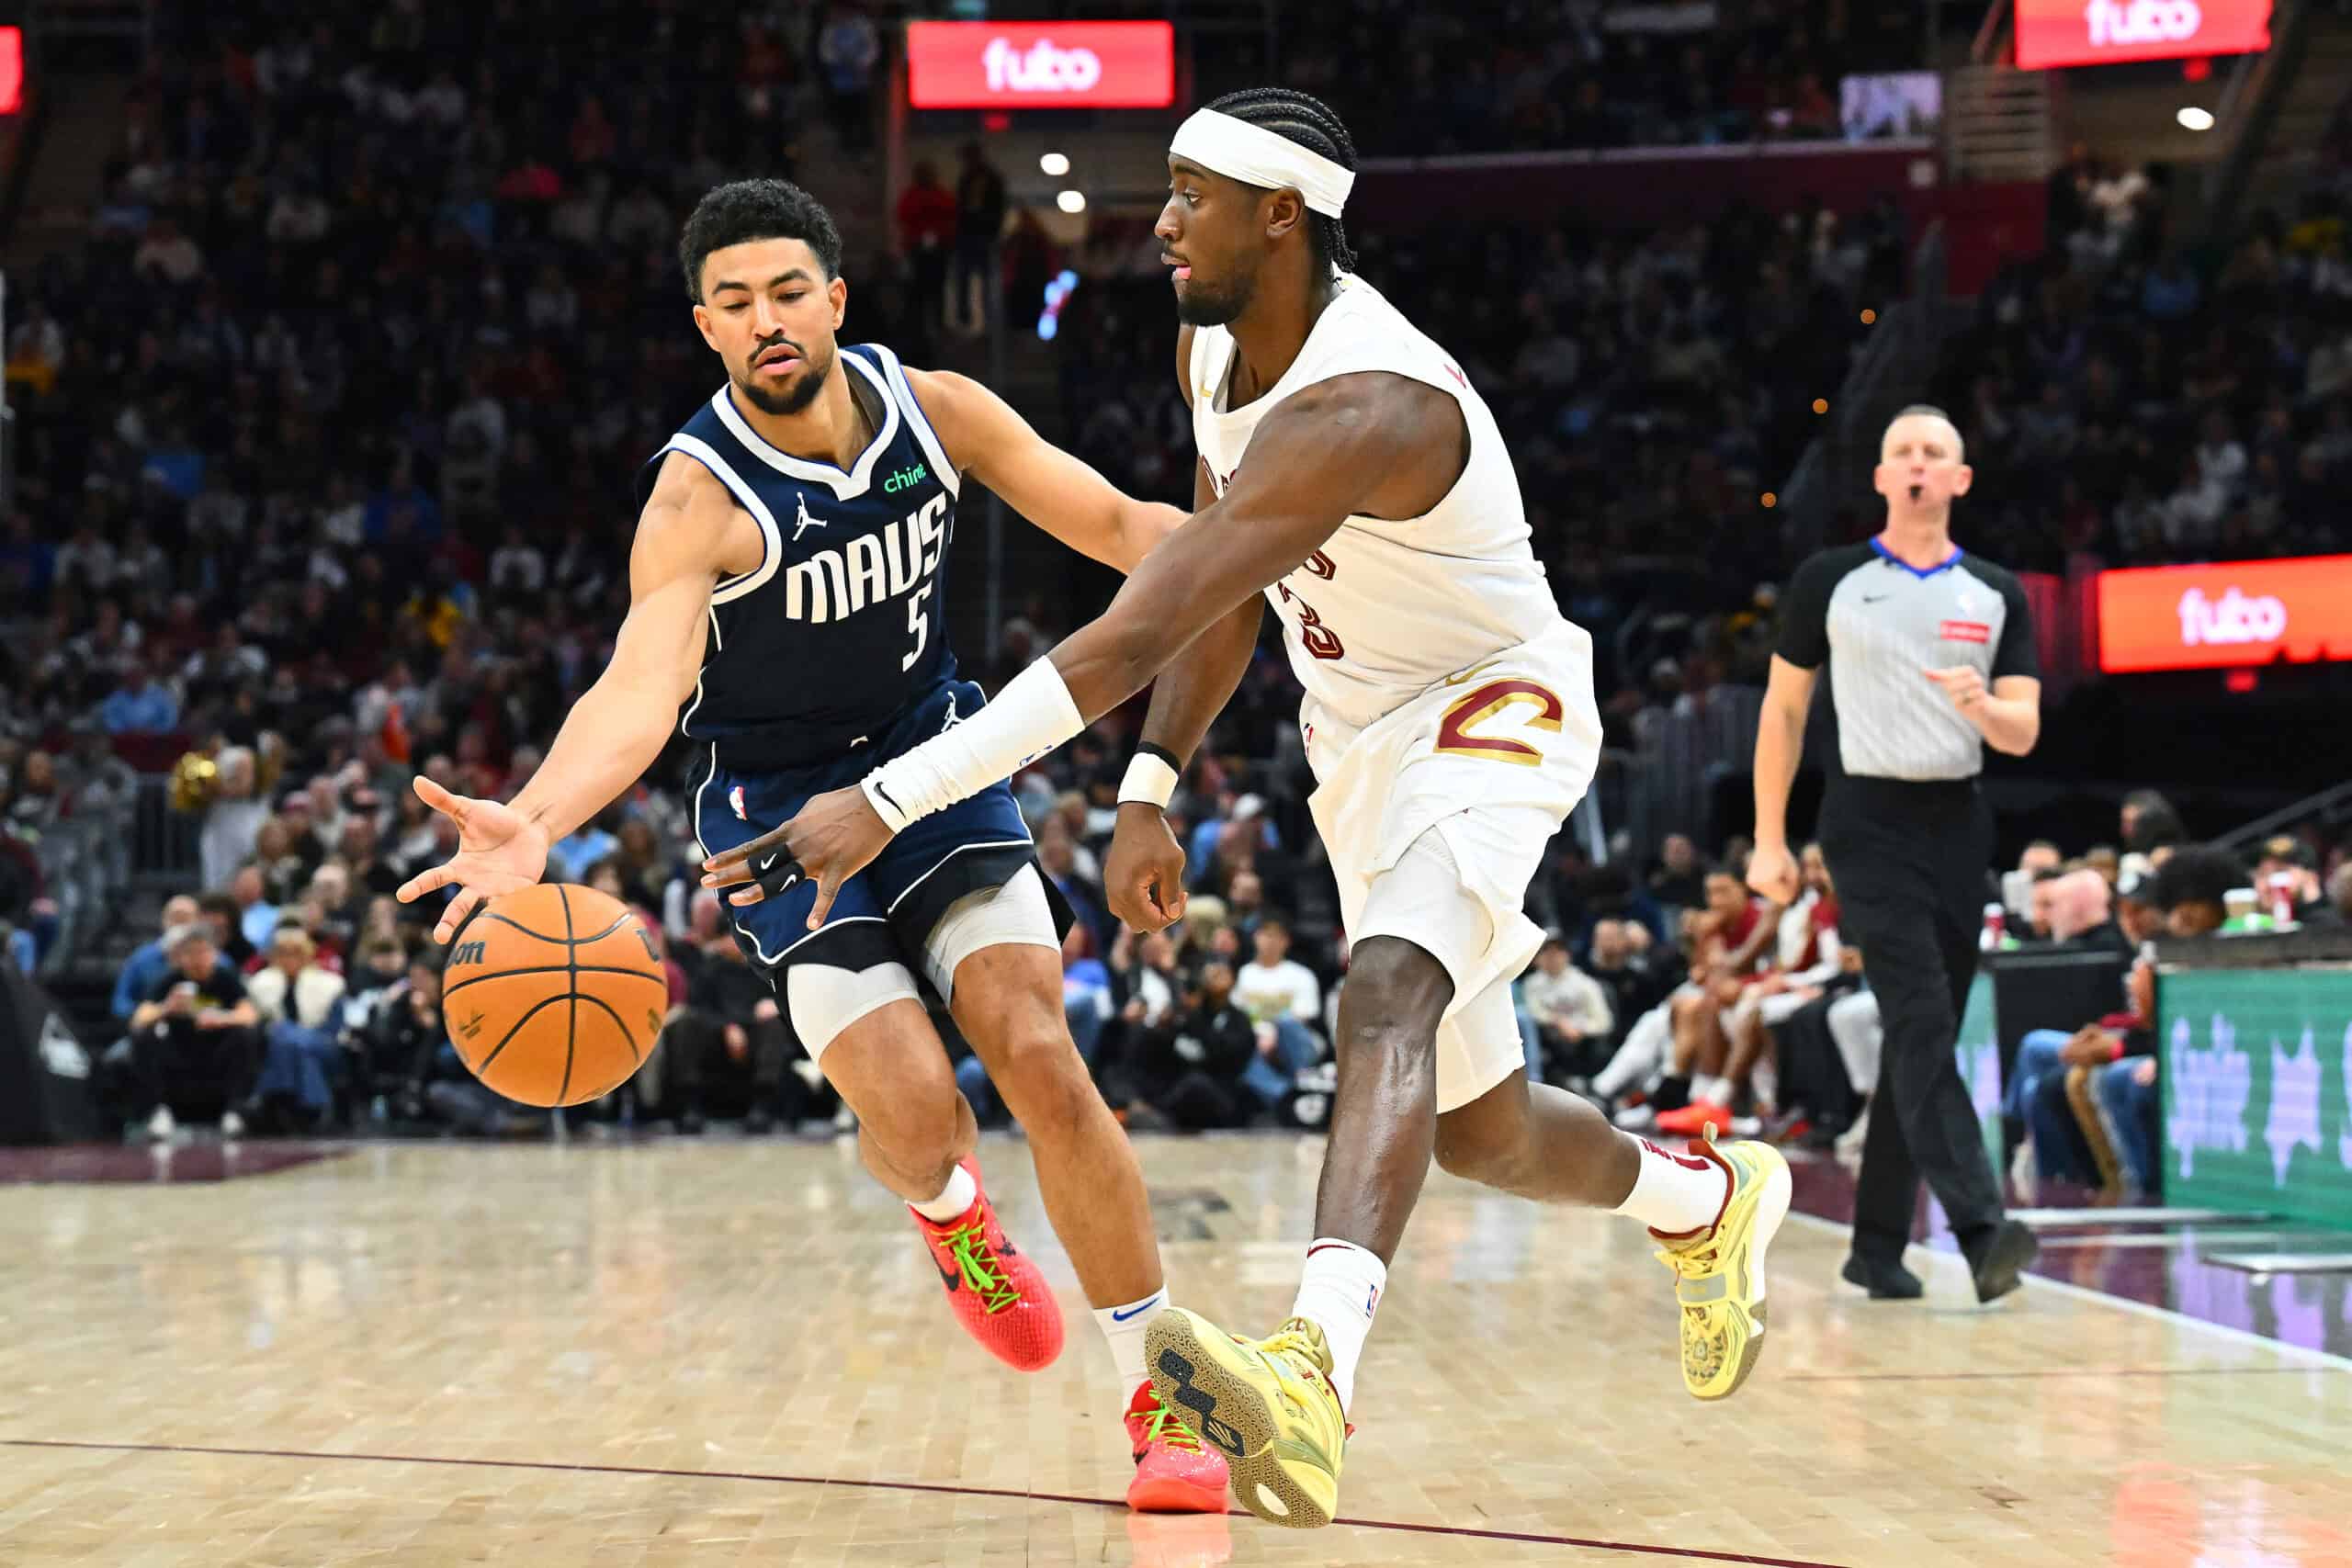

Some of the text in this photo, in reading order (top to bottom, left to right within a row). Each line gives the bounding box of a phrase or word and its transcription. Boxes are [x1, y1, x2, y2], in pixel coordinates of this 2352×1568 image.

[982, 38, 1101, 92] fubo
[902, 580, 933, 672] 5
[1278, 581, 1344, 660] 3
[2177, 585, 2287, 647] fubo
